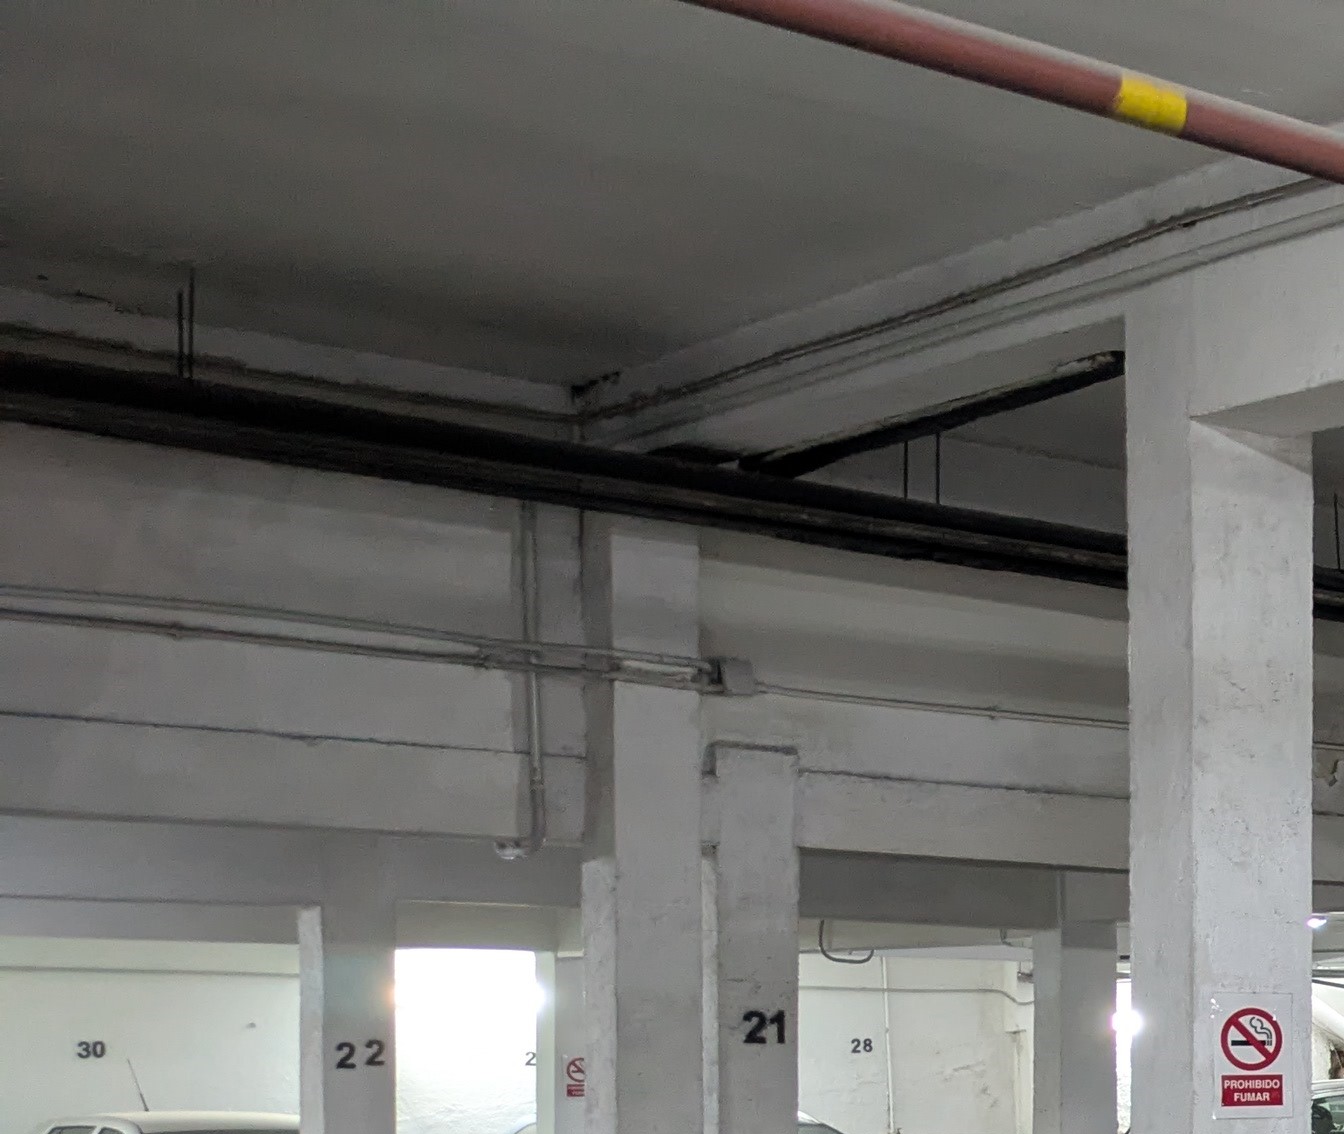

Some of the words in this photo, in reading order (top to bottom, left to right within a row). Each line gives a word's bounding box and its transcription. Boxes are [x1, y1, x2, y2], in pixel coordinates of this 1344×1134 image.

[742, 1010, 786, 1045] 21
[77, 1040, 106, 1059] 30
[850, 1038, 873, 1054] 28
[1224, 1079, 1280, 1090] PROHIBIDO
[1233, 1092, 1271, 1102] FUMAR
